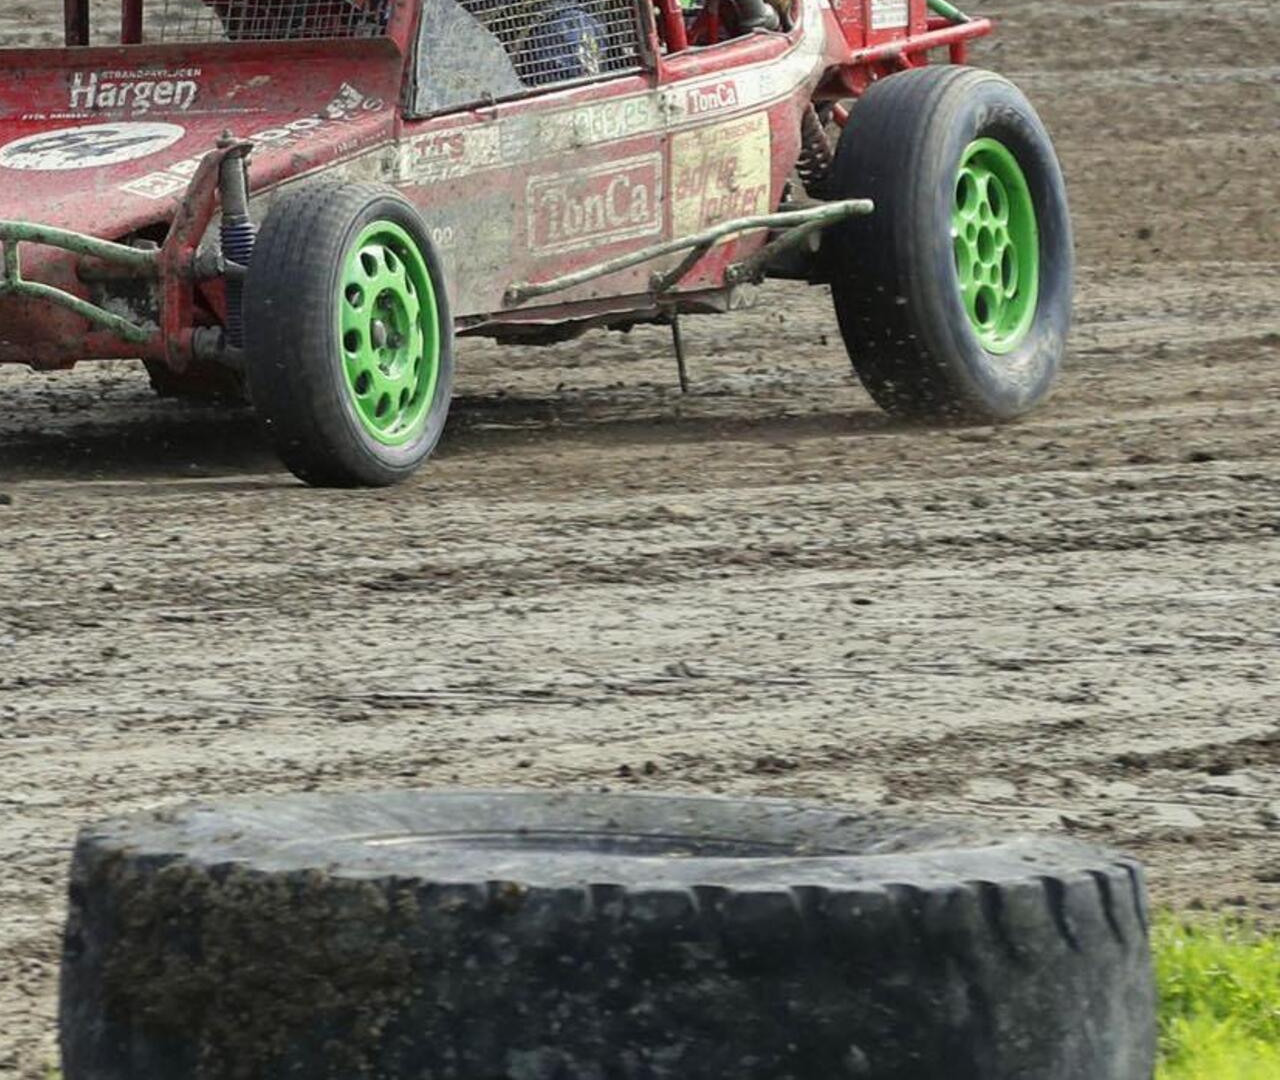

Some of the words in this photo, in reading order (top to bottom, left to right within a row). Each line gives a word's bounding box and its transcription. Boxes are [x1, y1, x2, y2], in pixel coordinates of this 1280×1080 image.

[69, 71, 198, 116] Hargen
[690, 82, 737, 112] TonCa
[540, 174, 649, 240] TonCa
